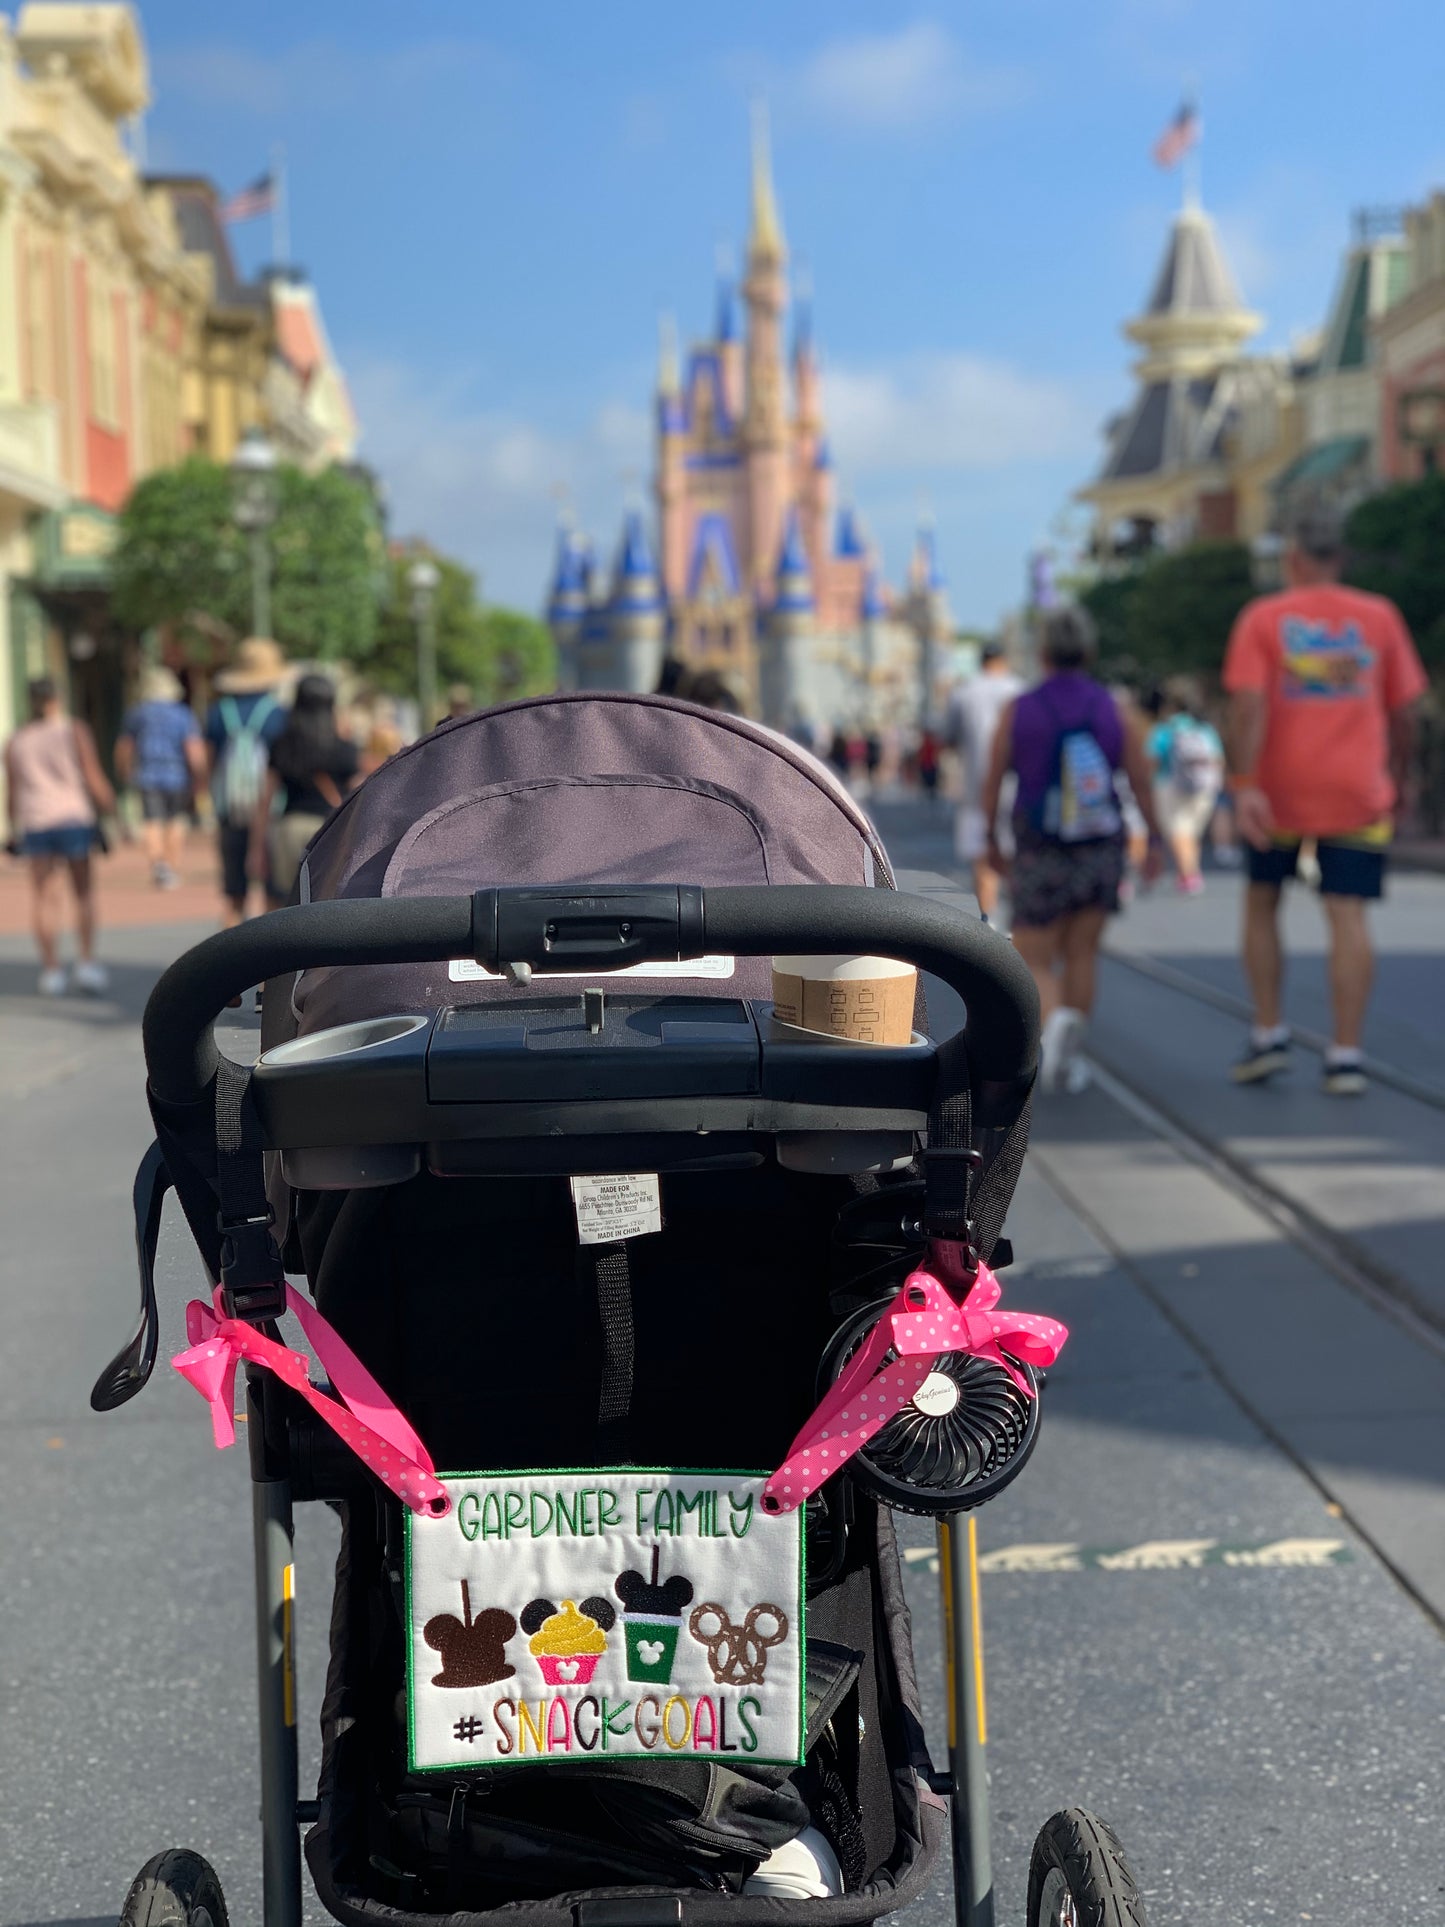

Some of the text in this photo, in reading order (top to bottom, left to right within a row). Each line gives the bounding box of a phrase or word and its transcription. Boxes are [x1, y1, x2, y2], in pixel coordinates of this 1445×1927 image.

[598, 1230, 614, 1239] MADE
[622, 1226, 641, 1234] CHINA
[458, 1488, 754, 1542] GARDNER FAMILY
